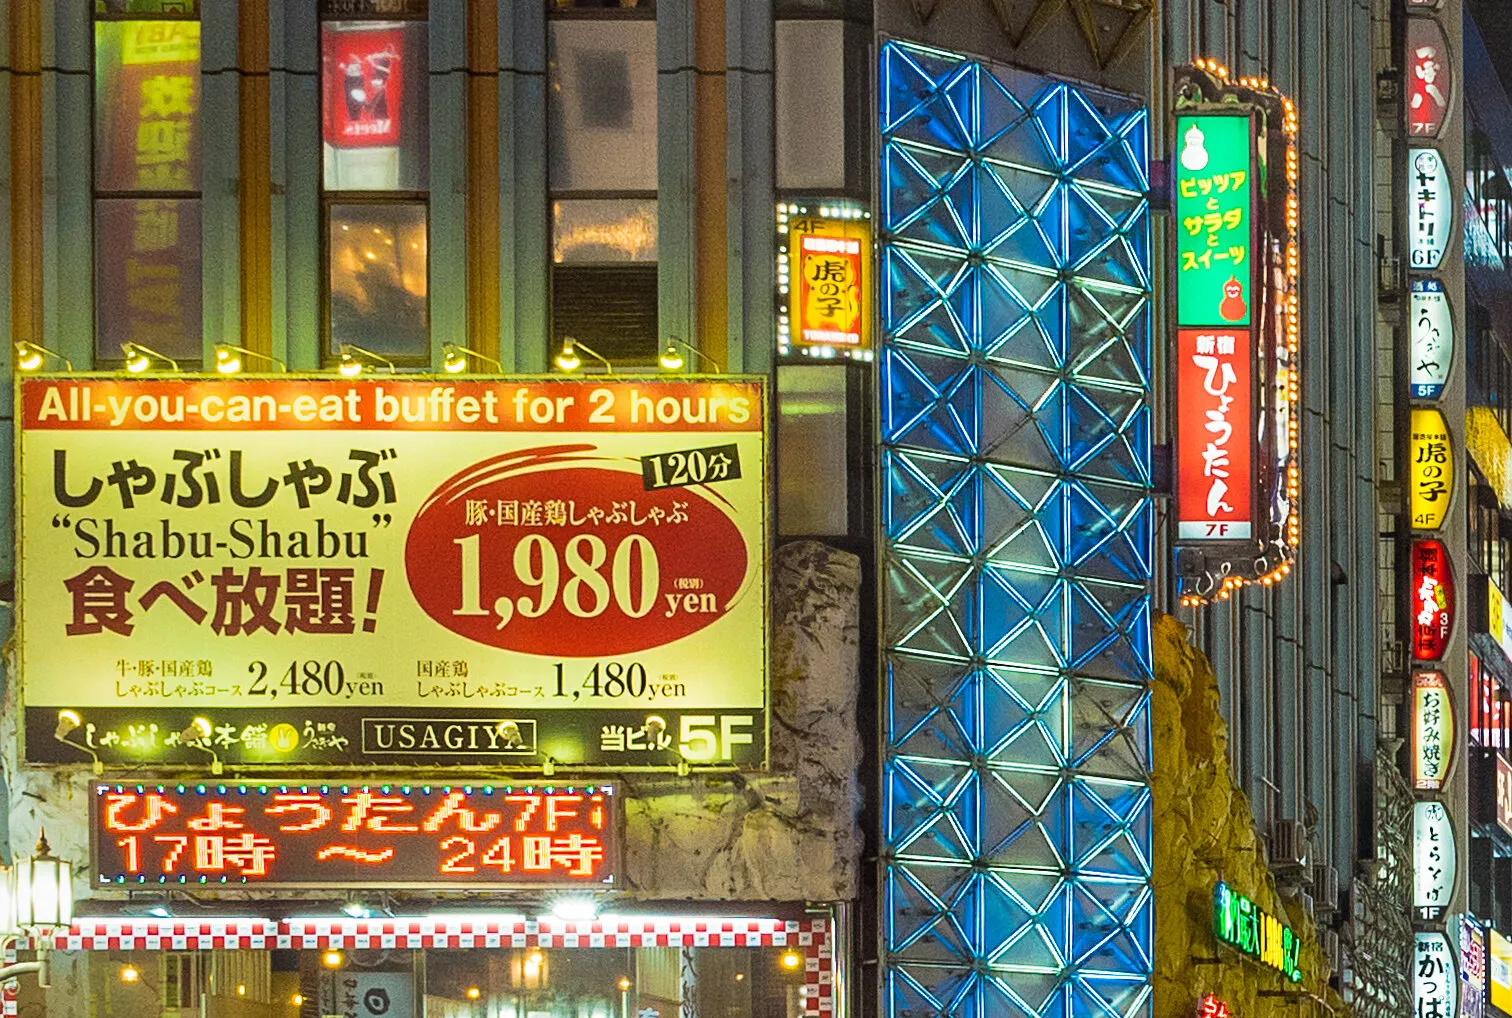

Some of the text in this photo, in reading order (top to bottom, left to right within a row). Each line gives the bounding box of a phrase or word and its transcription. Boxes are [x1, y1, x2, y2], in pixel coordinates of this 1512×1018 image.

[1411, 122, 1437, 133] 7F
[1207, 198, 1219, 211] と
[1183, 209, 1243, 236] サラダ
[1207, 234, 1219, 247] と
[1183, 247, 1245, 271] スイーツ
[1411, 249, 1441, 265] 6F
[812, 260, 845, 318] 虎の子
[1196, 335, 1236, 355] 新宿
[1417, 385, 1435, 396] 5F
[38, 386, 750, 425] All-you-can-eat buffet for 2 hours
[1193, 355, 1238, 517] ひょうたん
[53, 448, 397, 510] しゃぶしゃぶ
[649, 447, 733, 489] 120分
[1416, 442, 1448, 501] 虎の子
[465, 499, 690, 527] 豚・国産鶏しゃぶしゃぶ
[1414, 513, 1435, 525] 4F
[1206, 523, 1230, 537] 7F
[451, 533, 718, 631] 1,980 yen
[62, 567, 386, 637] 食べ放題!
[116, 660, 385, 703] しゃぶしゃぶコース 2,480 yen
[416, 659, 470, 679] 国産鶏
[416, 661, 687, 703] しゃぶしゃぶコース 1,480 yen
[679, 715, 754, 760] 5F
[1422, 691, 1442, 778] お好み焼き
[117, 836, 603, 875] 17時 24時
[1419, 906, 1441, 919] 1F
[1417, 941, 1444, 953] 新宿
